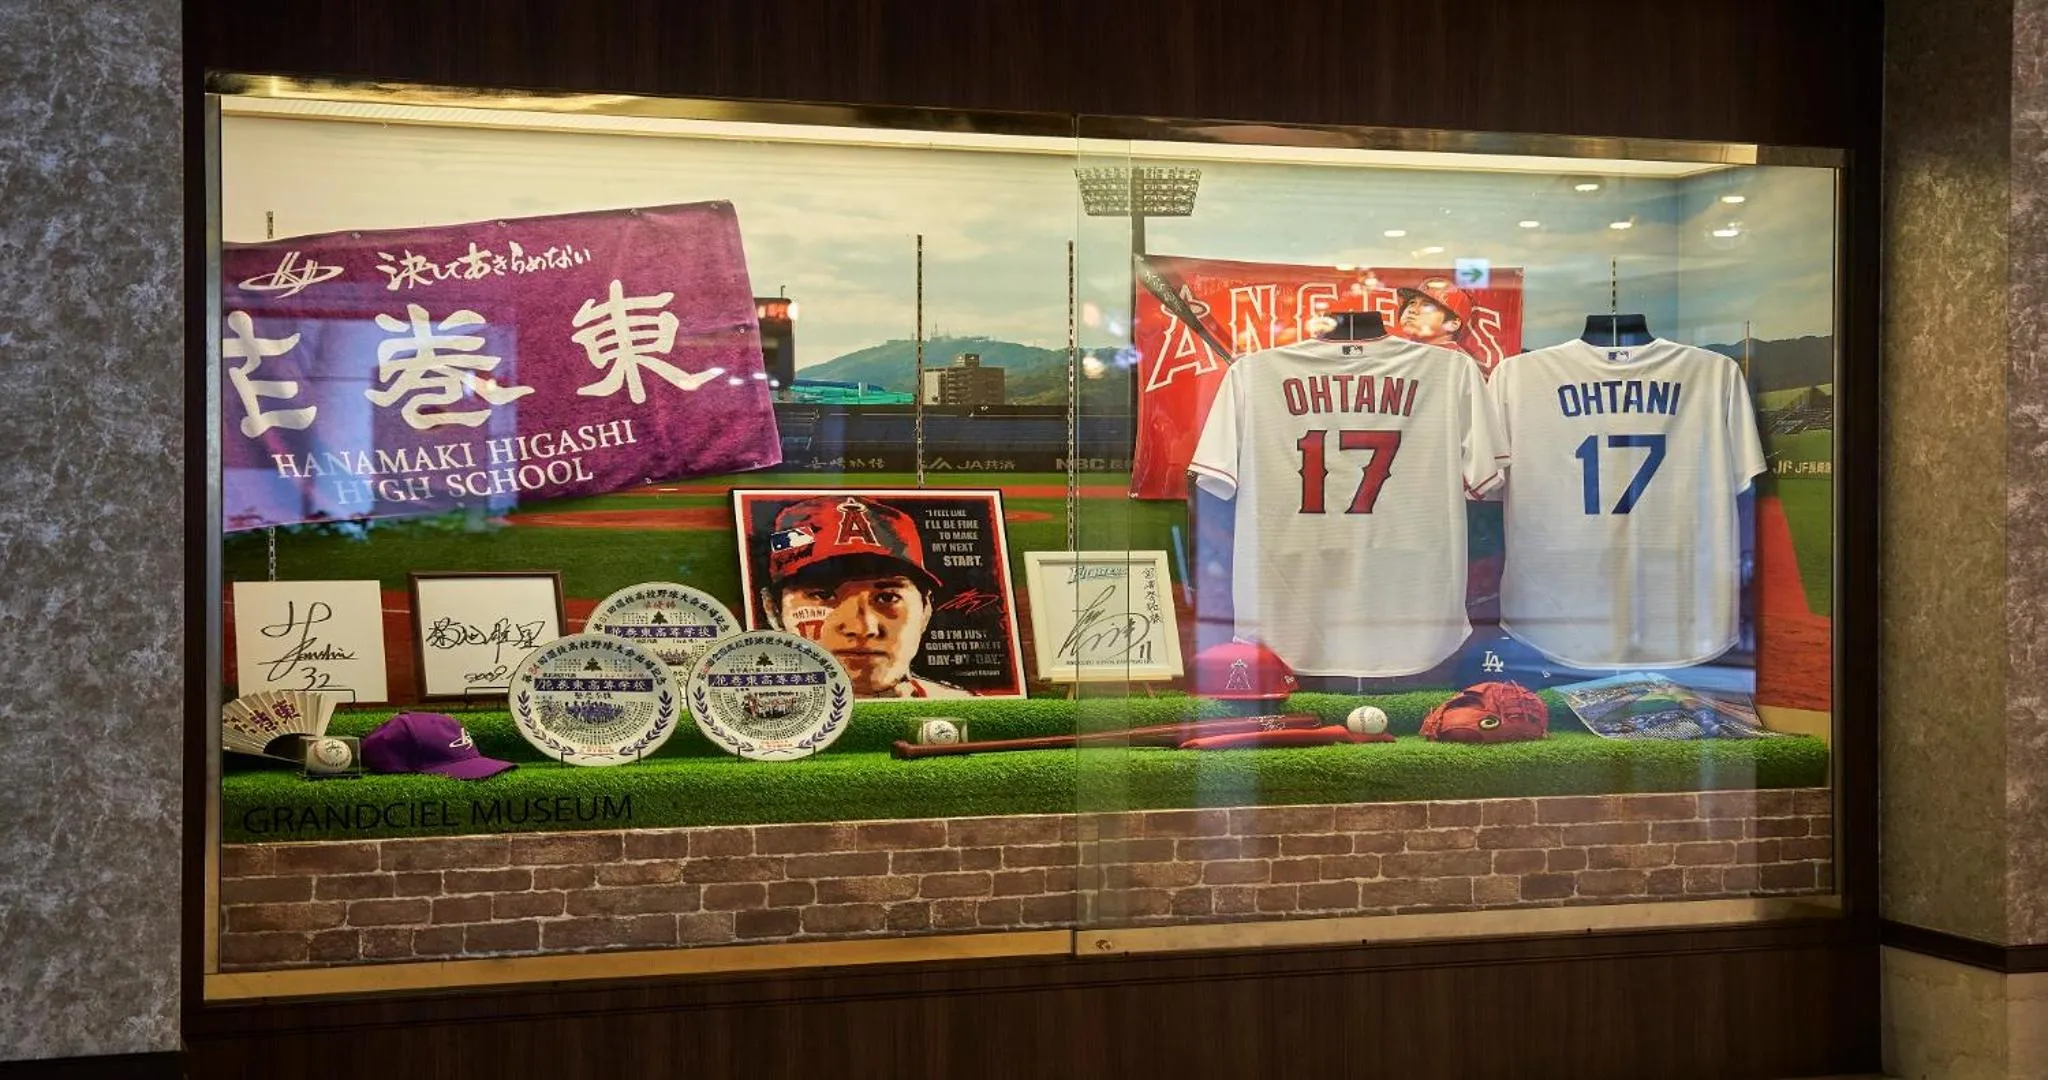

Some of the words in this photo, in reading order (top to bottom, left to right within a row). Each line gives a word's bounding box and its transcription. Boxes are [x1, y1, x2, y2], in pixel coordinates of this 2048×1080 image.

[376, 241, 591, 290] 決してあきらめない
[1283, 375, 1419, 417] OHTANI
[1557, 380, 1682, 417] OHTANI
[271, 442, 476, 479] HANAMAKI
[486, 419, 637, 465] HIGASHI
[333, 476, 436, 505] HIGH
[446, 458, 594, 497] SCHOOL
[1297, 429, 1403, 515] 17
[1575, 433, 1667, 515] 17
[939, 531, 951, 540] TO
[952, 531, 978, 540] MAKE
[943, 519, 955, 529] BE
[932, 542, 947, 552] MY
[949, 542, 974, 552] NEXT
[943, 555, 983, 567] START.
[925, 642, 955, 651] GOING
[956, 642, 968, 651] TO
[931, 630, 945, 640] SO
[1482, 650, 1504, 673] LA
[301, 666, 348, 691] 32
[243, 799, 460, 835] GRANDCIEL
[471, 794, 634, 826] MUSEUM
